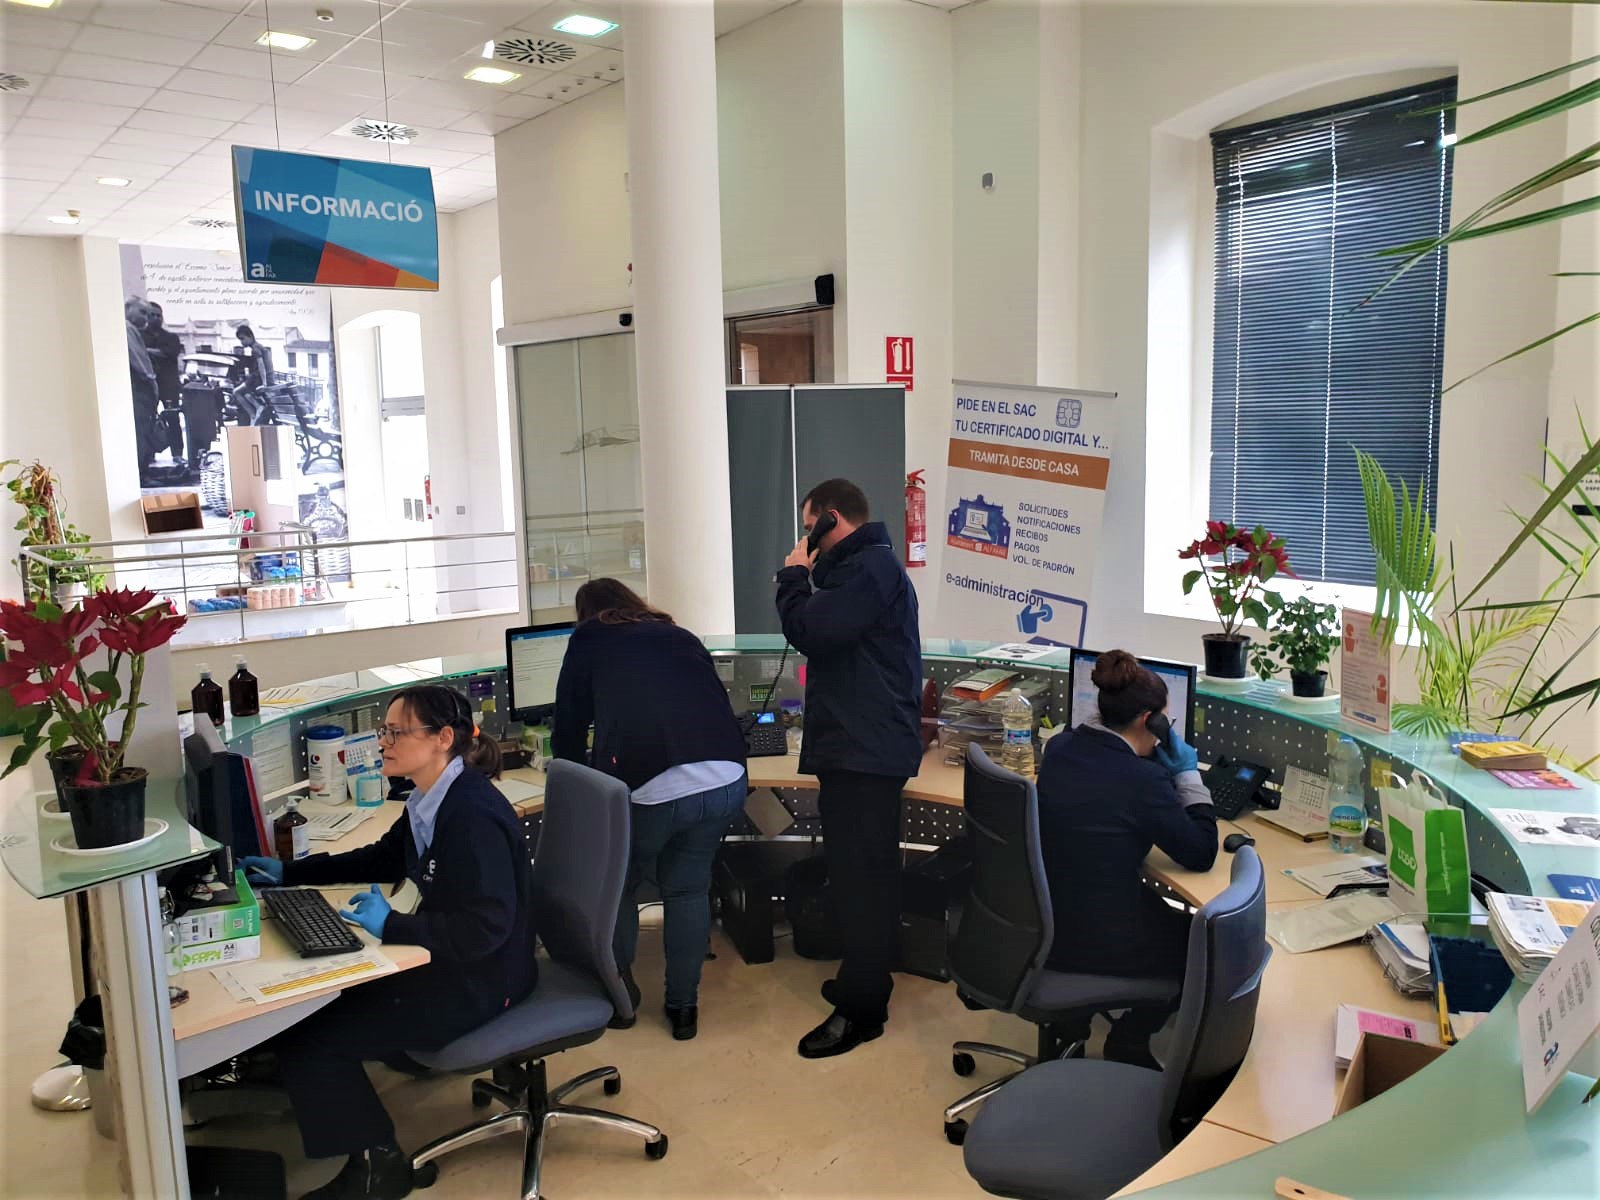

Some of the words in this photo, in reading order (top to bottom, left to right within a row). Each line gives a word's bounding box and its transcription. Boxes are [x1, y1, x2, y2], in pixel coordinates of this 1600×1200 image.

[254, 190, 424, 223] INFORMACIÓ
[250, 262, 266, 278] a
[957, 398, 978, 411] PIDE
[982, 400, 995, 413] EN
[999, 401, 1011, 415] EL
[1014, 403, 1037, 417] SAC
[956, 420, 968, 432] TU
[970, 421, 1041, 441] CERTIFICADO
[1043, 429, 1088, 447] DIGITAL
[970, 449, 1010, 465] TRAMITA
[1012, 456, 1047, 472] DESDE
[1049, 461, 1080, 477] CASA
[1018, 502, 1069, 519] SOLICITUDES
[1017, 516, 1081, 535] NOTIFICACIONES
[1016, 529, 1048, 542] RECIBOS
[1014, 542, 1040, 554] PAGOS
[1032, 559, 1041, 568] DE
